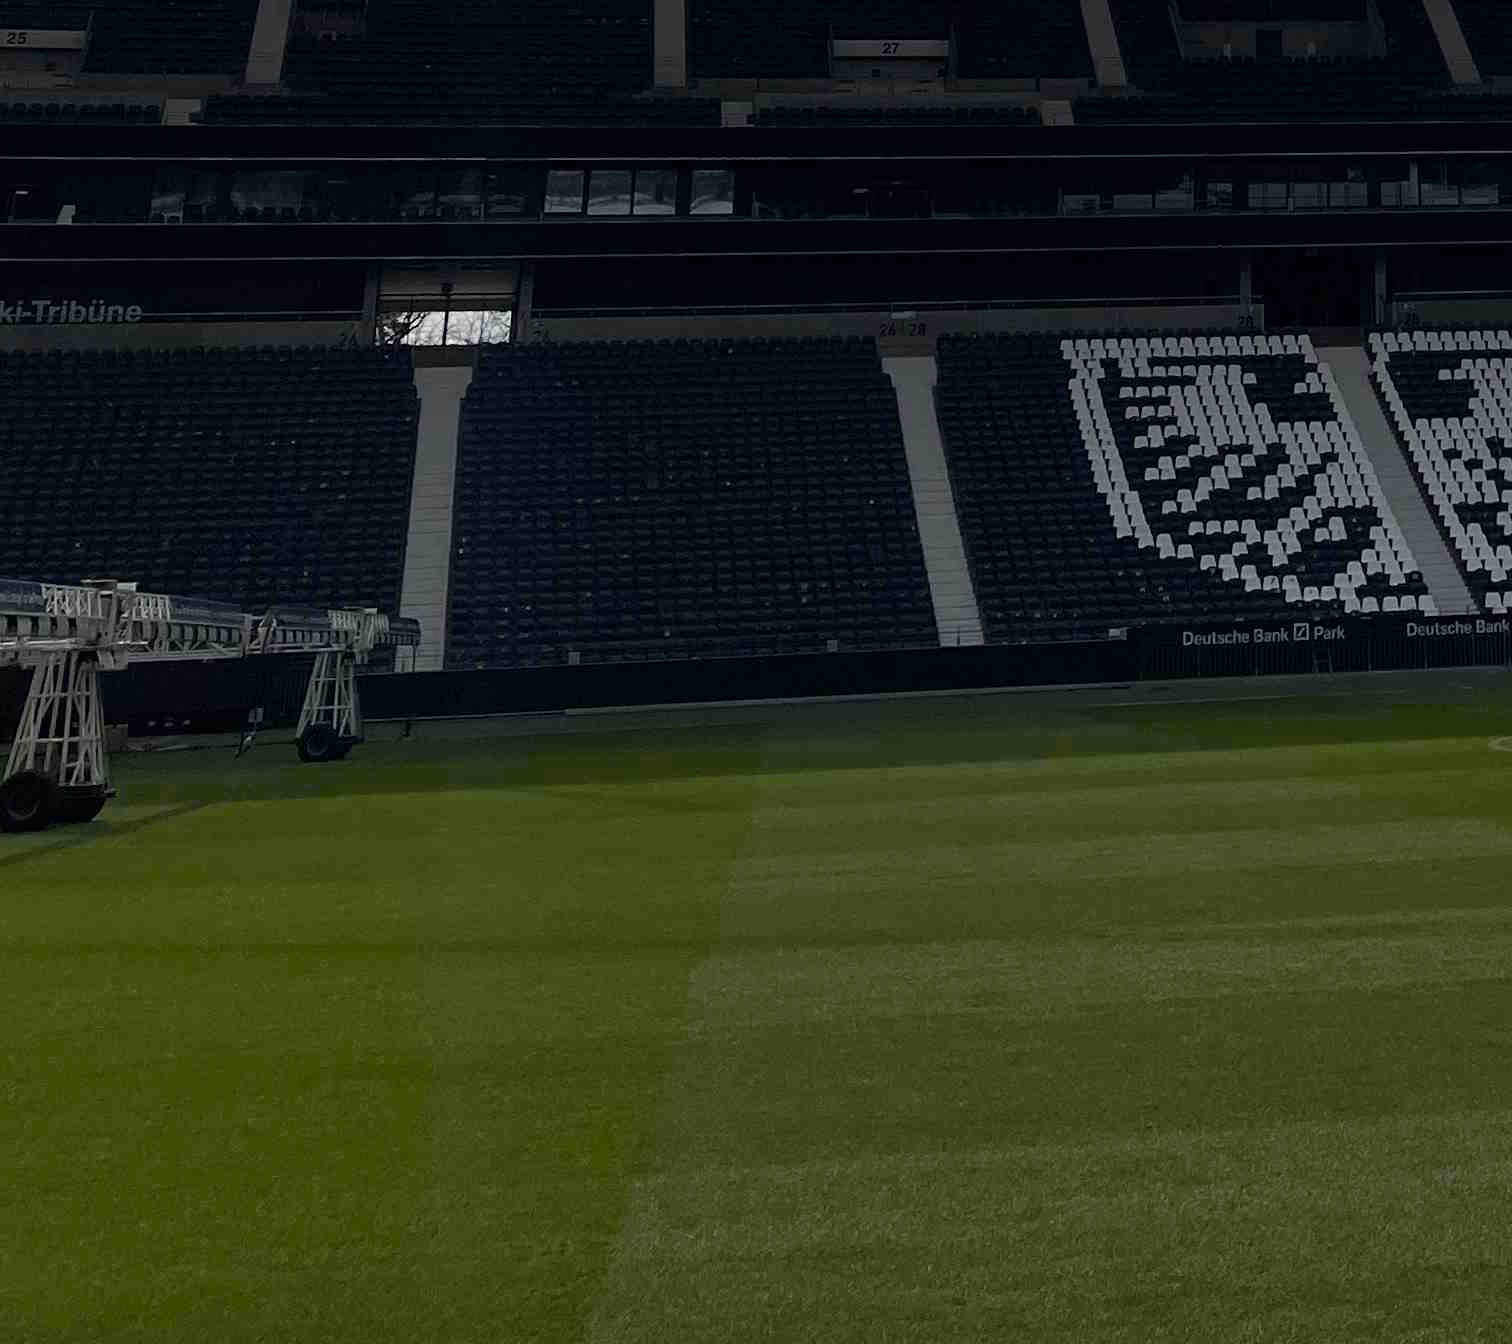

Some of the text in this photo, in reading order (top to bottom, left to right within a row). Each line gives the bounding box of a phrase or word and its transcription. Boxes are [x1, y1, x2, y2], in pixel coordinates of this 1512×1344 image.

[7, 31, 27, 45] 25
[882, 42, 899, 54] 27
[1183, 625, 1345, 646] Deutsche Bank Park
[1406, 620, 1473, 637] Deutsche
[1476, 618, 1511, 634] Bank
